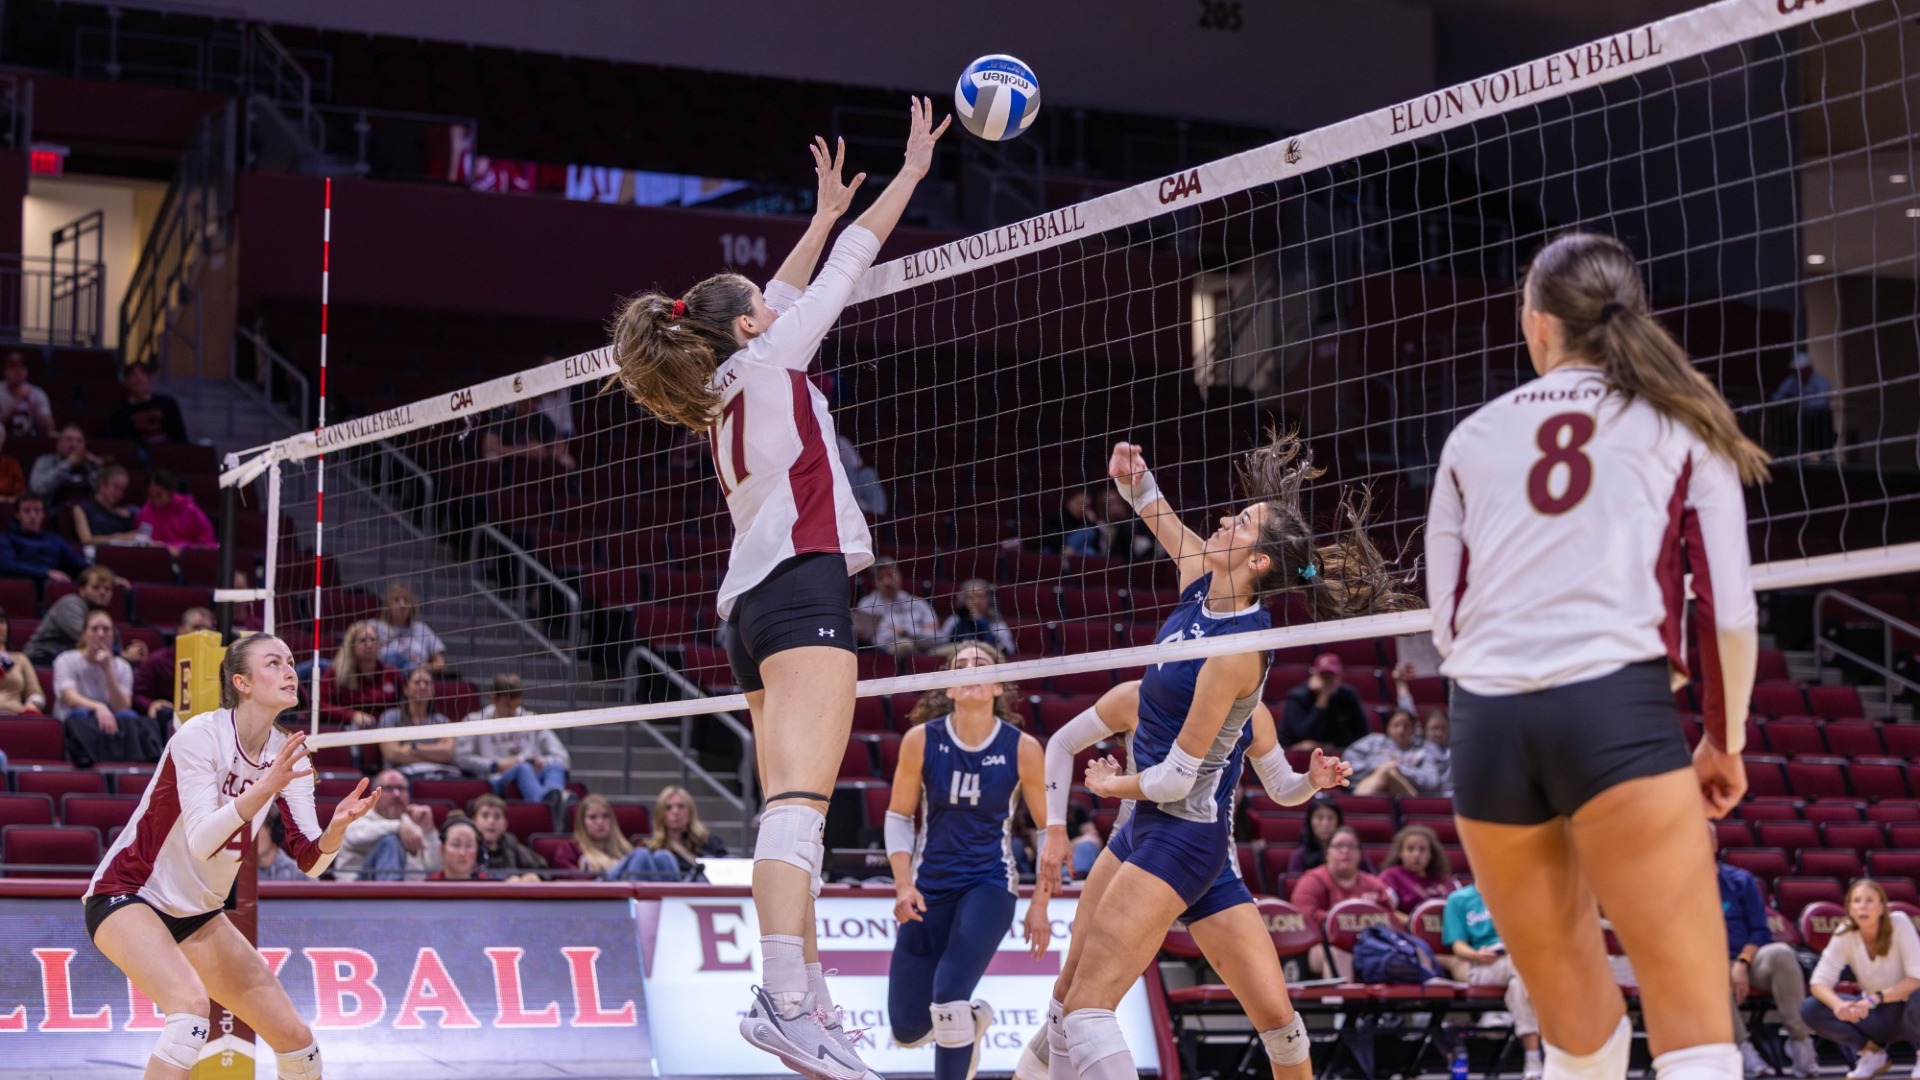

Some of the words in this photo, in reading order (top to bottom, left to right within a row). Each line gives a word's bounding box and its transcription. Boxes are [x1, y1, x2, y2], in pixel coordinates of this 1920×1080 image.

[982, 72, 1029, 90] molten
[1391, 85, 1467, 136] ELON
[1471, 26, 1663, 111] VOLLEYBALL
[1158, 168, 1202, 205] CAA
[720, 234, 767, 266] 104
[903, 242, 955, 281] ELON
[959, 205, 1086, 264] VOLLEYBALL
[563, 350, 603, 380] ELON
[450, 388, 474, 412] CAA
[1513, 387, 1602, 405] PHOEN
[315, 424, 346, 449] ELON
[345, 406, 415, 443] VOLLEYBALL
[1525, 410, 1597, 518] 8
[179, 660, 192, 712] E
[981, 754, 1006, 766] CAA
[949, 770, 981, 806] 14
[693, 904, 753, 972] E
[1263, 913, 1305, 932] LON
[0, 947, 638, 1031] LBALL
